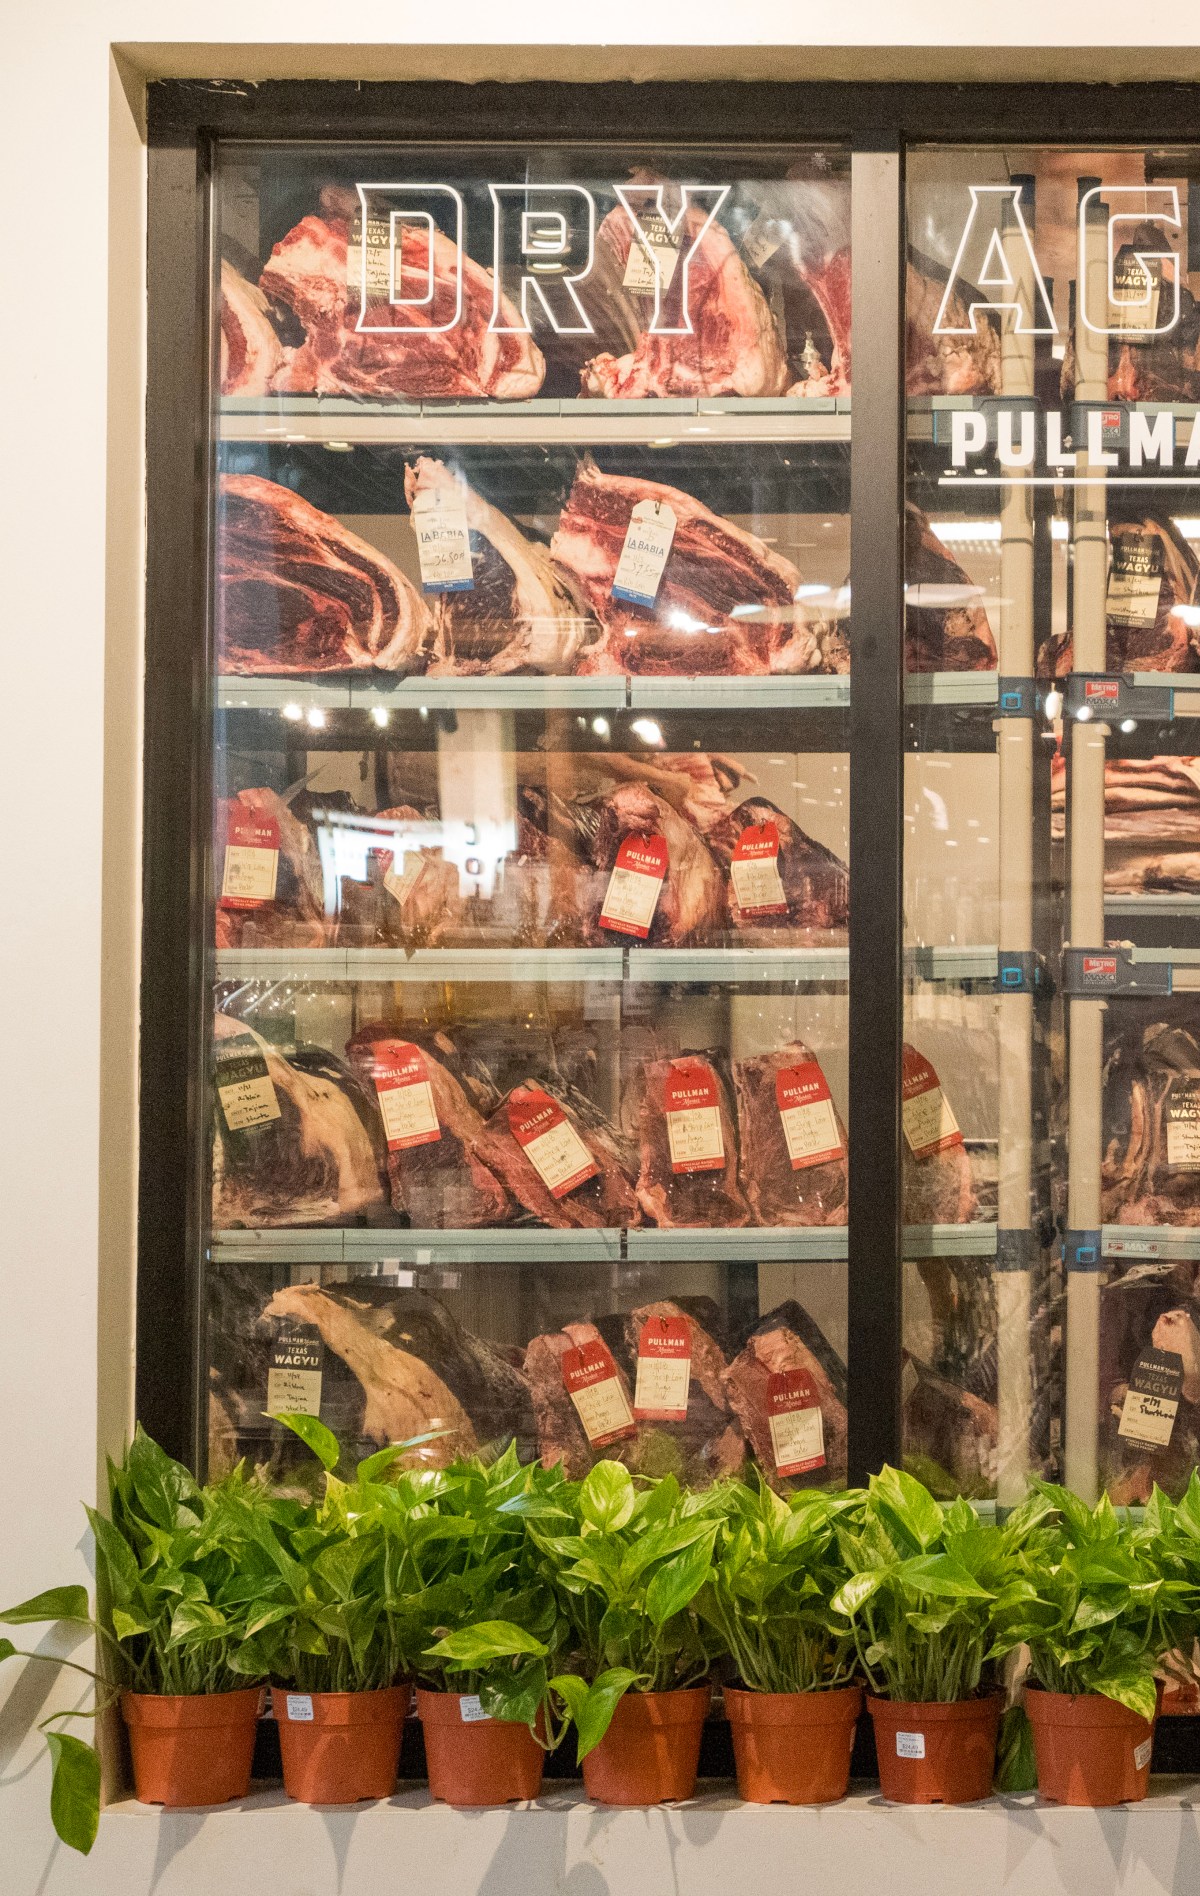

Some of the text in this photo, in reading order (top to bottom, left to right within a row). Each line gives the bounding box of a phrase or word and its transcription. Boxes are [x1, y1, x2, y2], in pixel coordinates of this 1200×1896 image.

[650, 223, 669, 234] TEXA
[354, 182, 731, 334] DRY
[1115, 276, 1158, 287] WAGYU
[421, 531, 434, 543] LA
[627, 537, 666, 557] LA BABIA
[1128, 555, 1150, 564] TEXAS
[1116, 562, 1160, 574] WAGYU
[1091, 684, 1117, 692] METRO
[742, 841, 775, 852] PULLMAN
[626, 850, 662, 867] PULLMAN
[1088, 960, 1115, 968] METRO
[382, 1064, 420, 1080] PULLMAN
[671, 1087, 710, 1100] PULLMAN
[783, 1082, 821, 1099] PULLMAN
[518, 1106, 555, 1134] PULLMAN
[279, 1336, 304, 1344] PULLMAN
[647, 1337, 685, 1347] PULLMAN
[288, 1346, 309, 1355] TEXAS
[274, 1354, 320, 1367] WAGYU
[1139, 1360, 1166, 1373] PULLMAN
[569, 1360, 607, 1380] PULLMAN
[1148, 1372, 1169, 1383] TEXAS
[1135, 1378, 1178, 1396] WAGYU
[773, 1388, 811, 1403] PULLMAN
